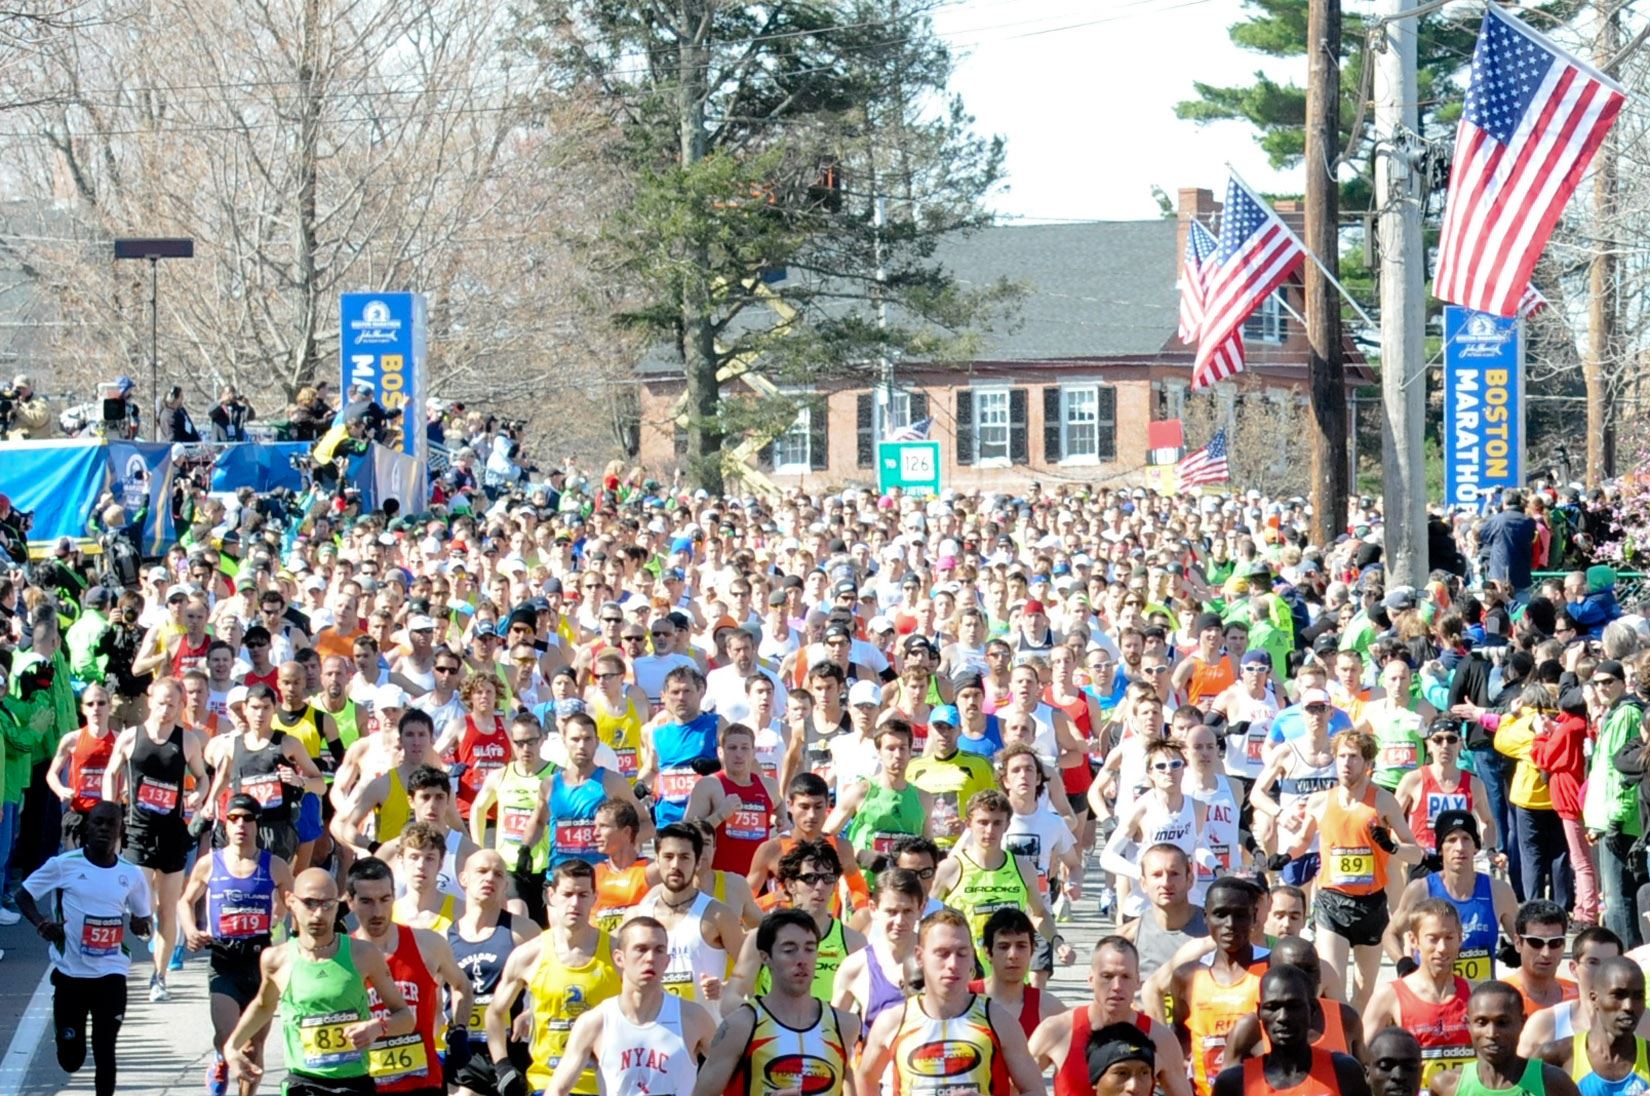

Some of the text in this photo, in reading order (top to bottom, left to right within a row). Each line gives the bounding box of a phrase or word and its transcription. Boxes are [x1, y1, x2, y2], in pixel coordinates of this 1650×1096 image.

[1485, 369, 1508, 477] BOSTON
[905, 456, 929, 472] 126
[671, 776, 695, 792] 105
[148, 788, 172, 804] 132
[735, 811, 760, 827] 755
[1206, 804, 1232, 824] YAC
[1340, 857, 1363, 873] 89
[964, 886, 1020, 894] BROOKS
[230, 914, 261, 931] 119
[91, 928, 118, 943] 521
[1452, 960, 1480, 979] 50
[323, 1011, 359, 1025] adidas
[313, 1026, 348, 1050] 83
[387, 1032, 422, 1048] adidas
[382, 1044, 413, 1070] 46
[1442, 1047, 1476, 1057] adidas
[619, 1047, 670, 1074] NYAC
